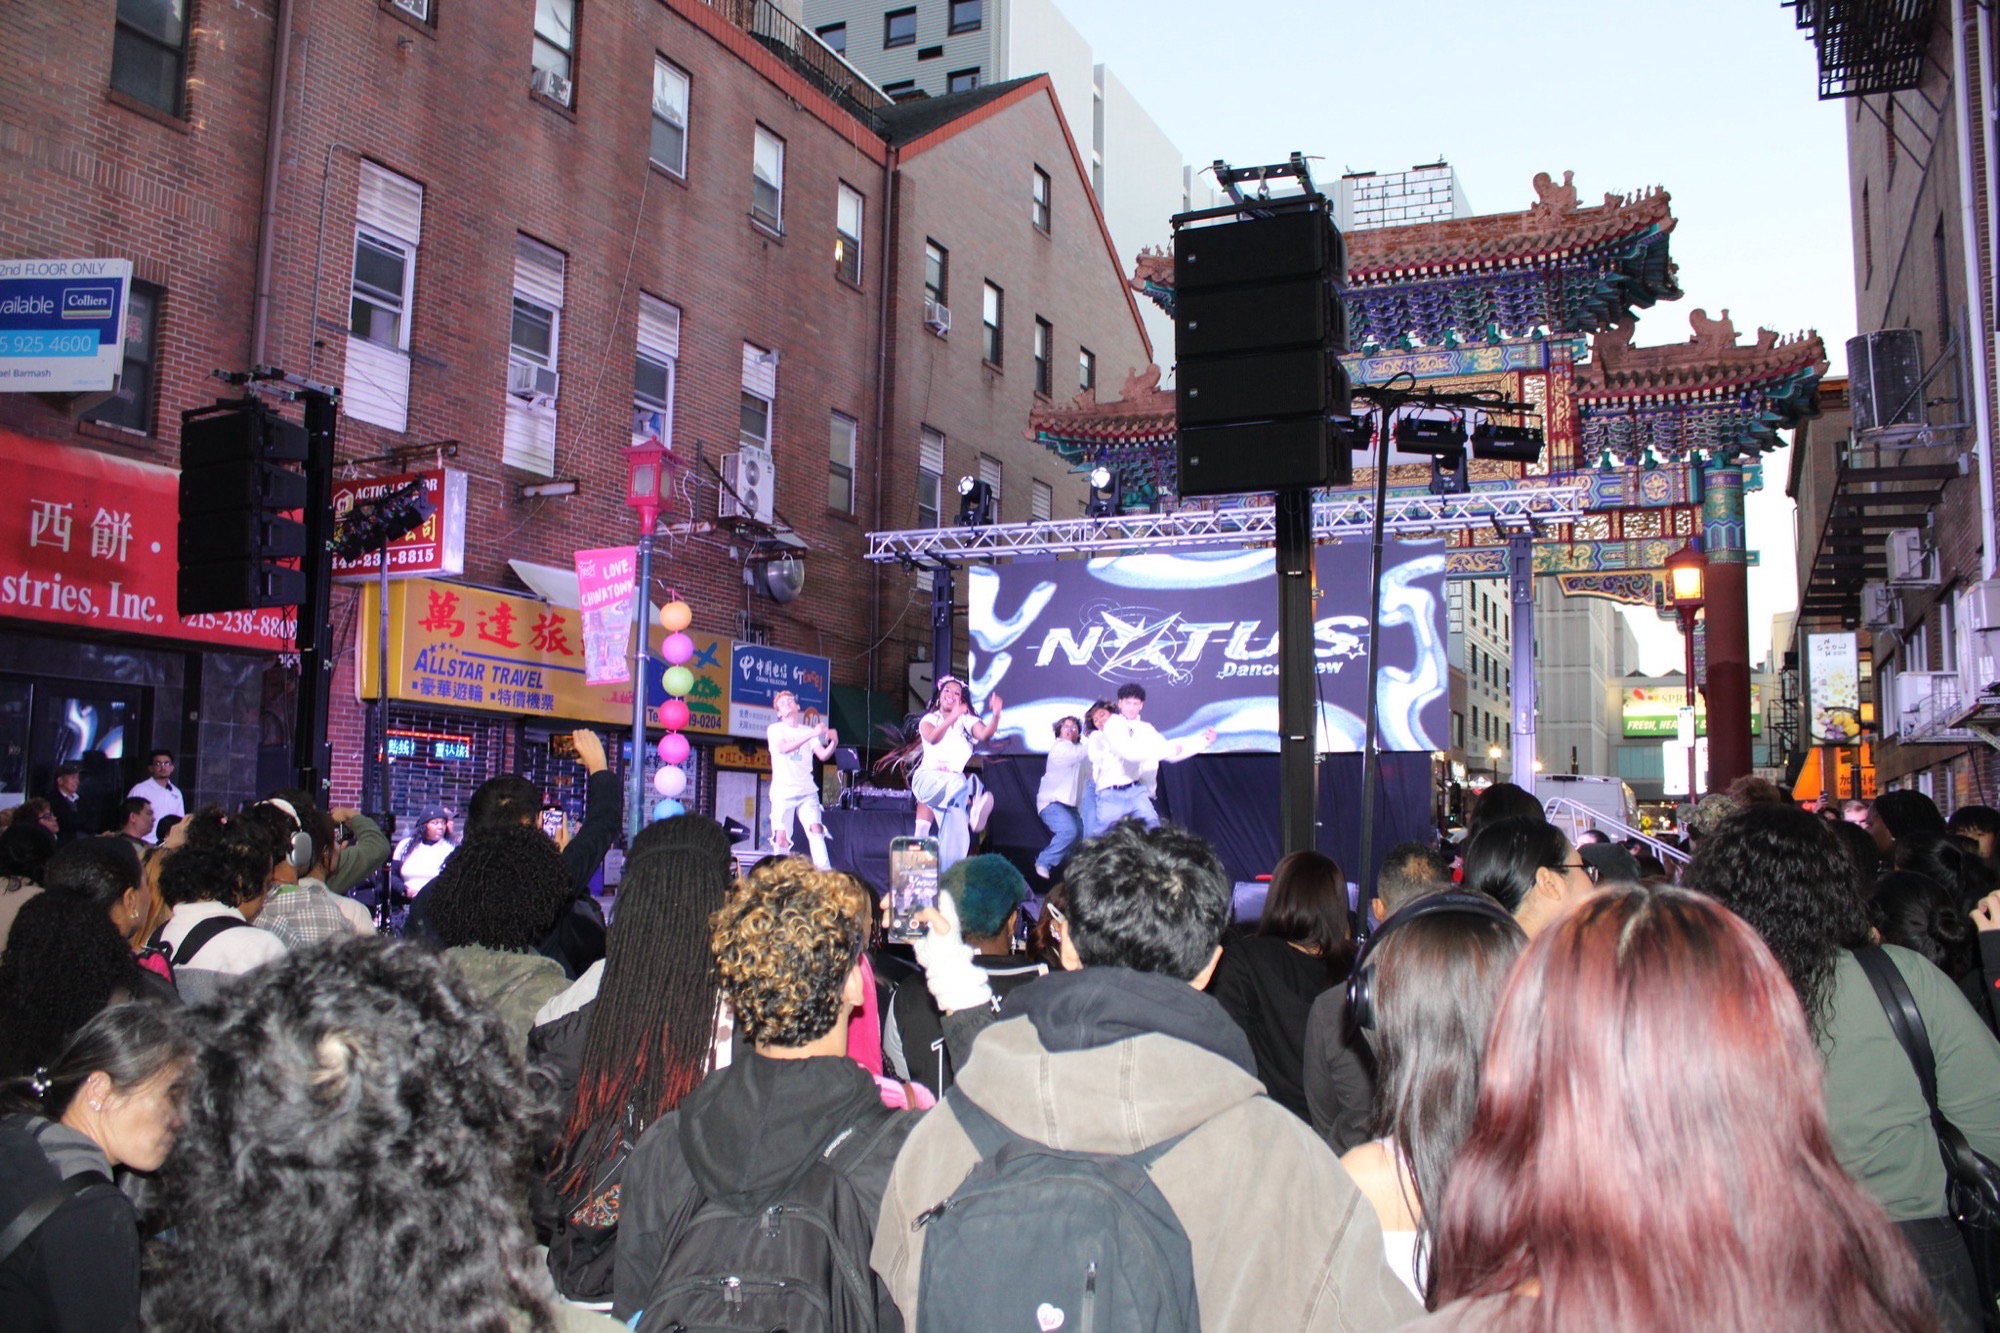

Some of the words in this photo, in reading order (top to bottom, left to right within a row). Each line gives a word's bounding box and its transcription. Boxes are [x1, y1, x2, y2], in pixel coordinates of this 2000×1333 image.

[0, 264, 21, 276] 2nd
[25, 263, 67, 275] FLOOR
[71, 262, 106, 275] ONLY
[68, 295, 107, 306] Colliers
[13, 336, 44, 352] 925
[48, 336, 92, 352] 4600
[13, 369, 51, 378] Barmash
[602, 558, 632, 580] LOVE,
[581, 577, 634, 606] CHINATOWN
[106, 581, 164, 624] Inc.
[413, 648, 486, 682] ALLSTAR
[492, 665, 544, 690] TRAVEL
[497, 688, 555, 712] 特價機票
[1626, 720, 1657, 731] FRESH,
